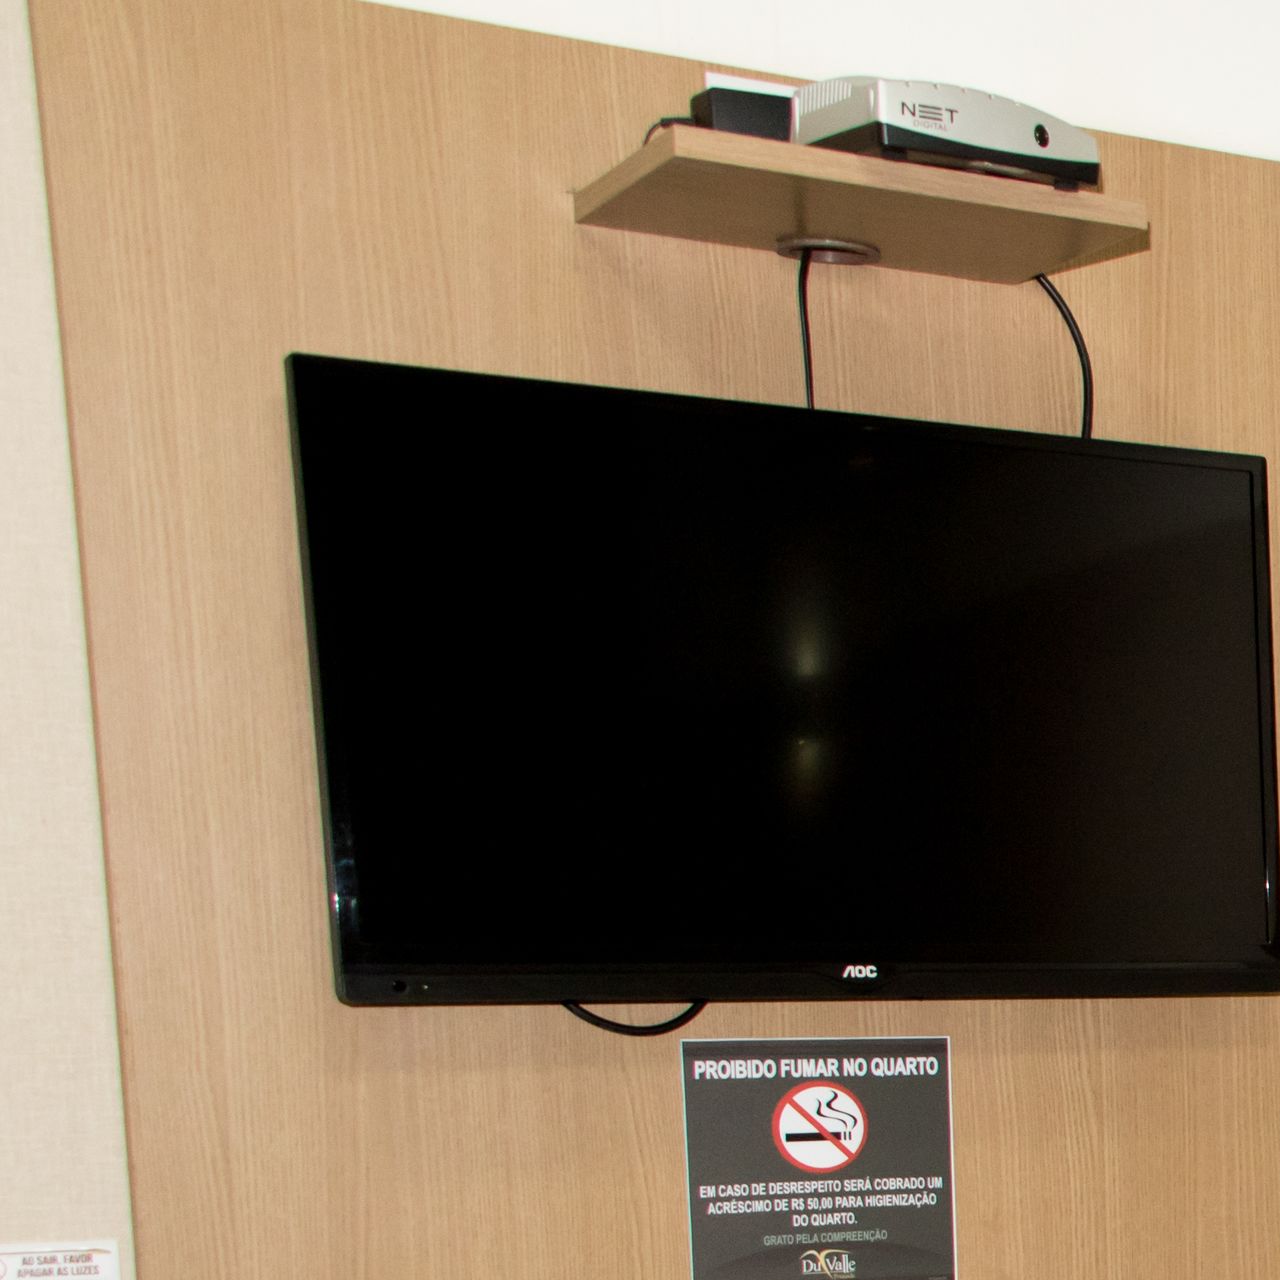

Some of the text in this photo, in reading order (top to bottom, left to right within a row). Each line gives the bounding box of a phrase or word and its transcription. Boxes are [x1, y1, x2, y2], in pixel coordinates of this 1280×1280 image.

[901, 101, 959, 124] NET
[842, 965, 878, 978] AOC
[694, 1056, 939, 1080] PROIBIDO FUMAR NO QUARTO
[699, 1176, 943, 1198] EM CASO DE DESRESPEITO SERÁ COBRADO UM
[707, 1199, 772, 1215] ACRÉSCIMO
[774, 1199, 789, 1212] DE
[791, 1198, 805, 1211] R$
[835, 1195, 864, 1209] PARA
[865, 1191, 937, 1208] HIGIENIZAÇÃO
[793, 1212, 858, 1227] DO QUARTO.
[763, 1234, 794, 1246] GRATO
[796, 1233, 819, 1244] PELA
[64, 1253, 94, 1264] FAVOR
[17, 1265, 100, 1278] APAGAR AS LUZES
